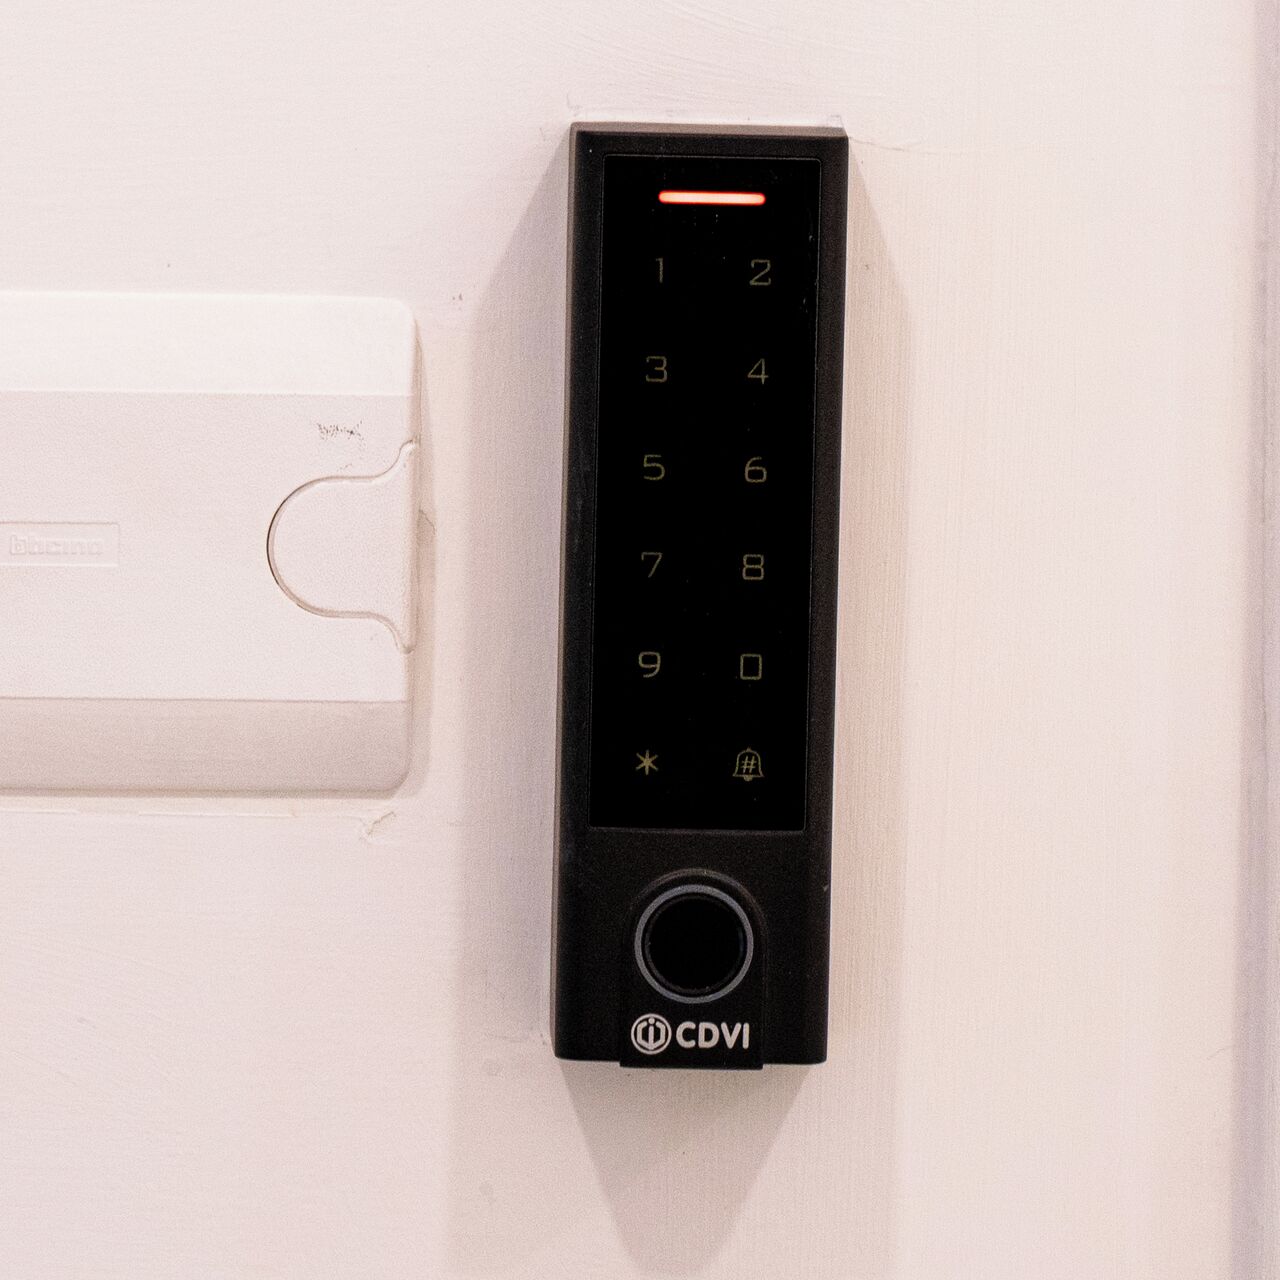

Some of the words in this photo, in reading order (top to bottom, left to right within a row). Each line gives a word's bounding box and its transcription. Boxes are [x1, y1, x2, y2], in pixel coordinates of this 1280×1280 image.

[655, 257, 665, 284] 1
[749, 259, 772, 286] 2
[645, 355, 668, 383] 3
[747, 358, 769, 385] 4
[643, 454, 666, 481] 5
[744, 456, 768, 484] 6
[640, 551, 663, 578] 7
[741, 553, 765, 581] 8
[638, 651, 662, 678] 9
[739, 653, 763, 681] 0
[675, 1021, 750, 1050] CDVI
